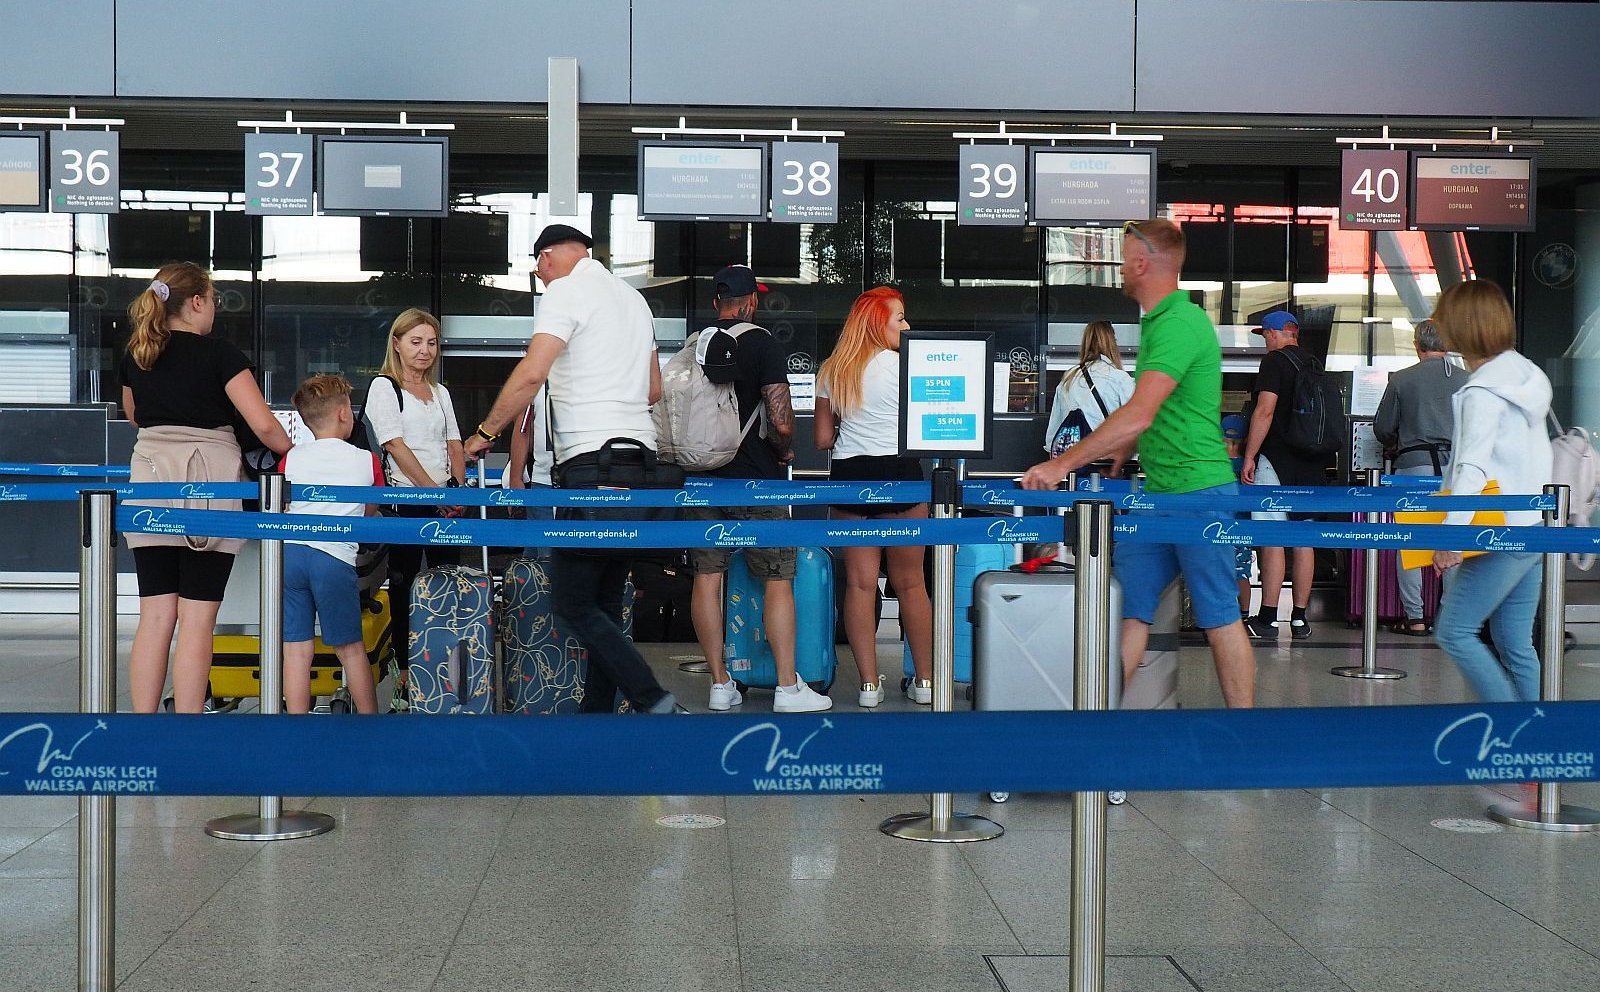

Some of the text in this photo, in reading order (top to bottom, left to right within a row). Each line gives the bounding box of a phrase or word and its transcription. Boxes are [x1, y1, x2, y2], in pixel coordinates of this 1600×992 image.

[60, 150, 110, 186] 36
[256, 152, 304, 188] 37
[1070, 158, 1110, 170] enter
[1451, 163, 1491, 175] enter
[672, 174, 708, 183] HURGHADA
[782, 160, 832, 196] 38
[969, 164, 1017, 198] 39
[1062, 180, 1099, 188] HURGHADA
[1351, 168, 1399, 203] 40
[927, 352, 958, 361] enter
[257, 522, 352, 533] www.airport.gdansk.pl
[544, 528, 638, 538] www.airport.gdansk.pl
[827, 526, 920, 537] www.airport.gdansk.pl
[1321, 531, 1412, 541] www.airport.gdansk.pl
[1491, 752, 1594, 765] GDANSK LECH
[52, 766, 157, 778] GDANSK LECH
[780, 764, 883, 776] GDANSK LECH
[1465, 766, 1592, 780] WALESA AIRPORT
[25, 780, 155, 792] WALESA AIRPORT
[753, 778, 881, 790] WALESA AIRPORT
